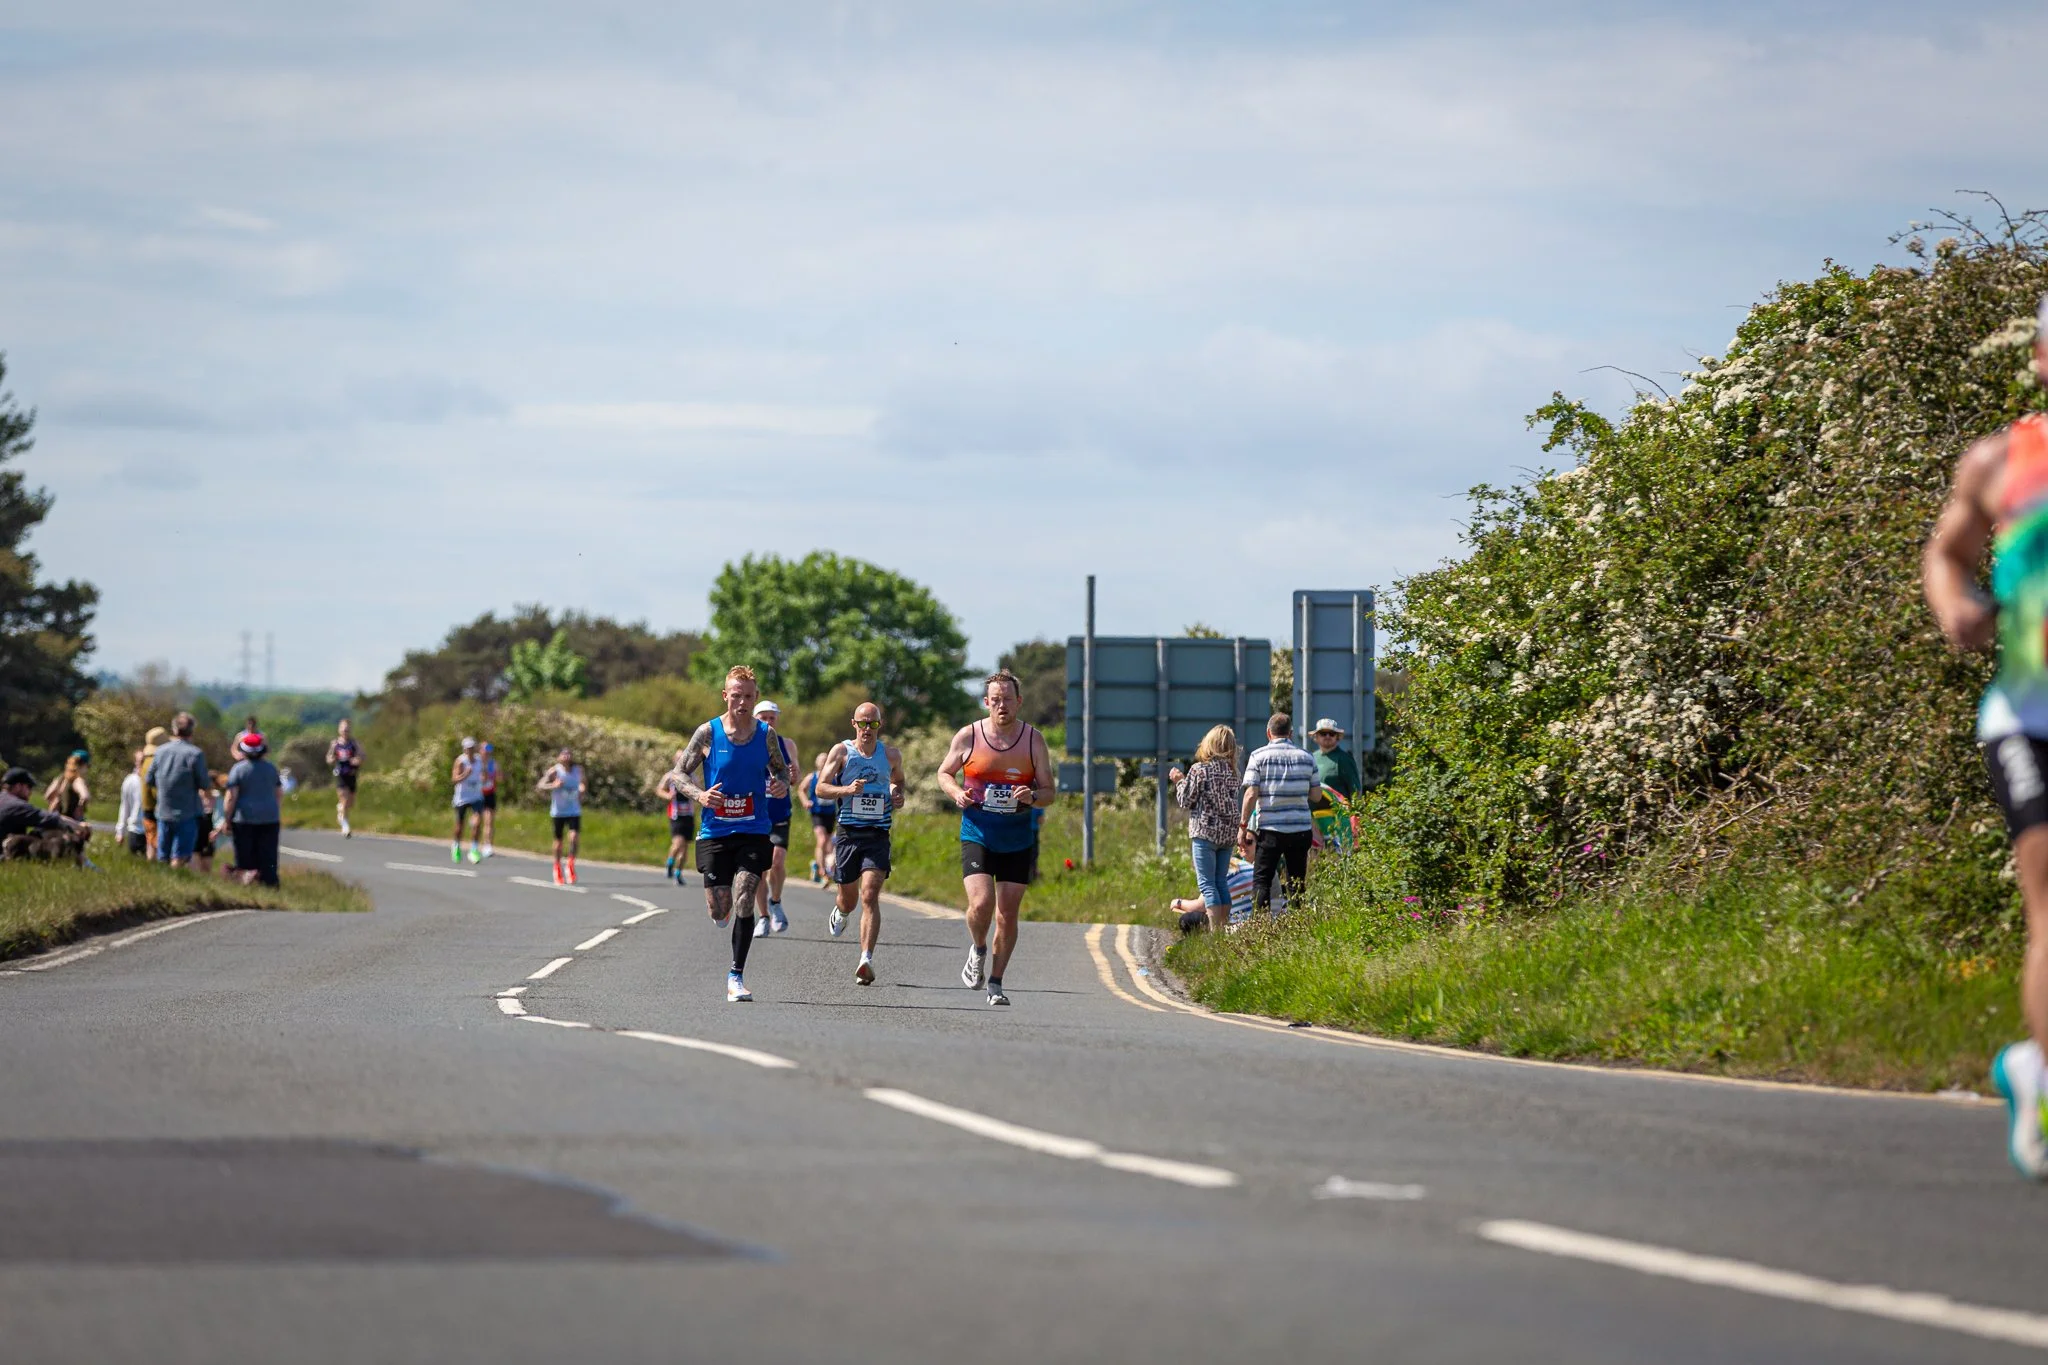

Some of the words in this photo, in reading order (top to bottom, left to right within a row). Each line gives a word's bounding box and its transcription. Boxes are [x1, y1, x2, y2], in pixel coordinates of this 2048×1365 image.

[993, 790, 1011, 798] 554
[724, 798, 747, 808] 1092
[861, 798, 877, 806] 520
